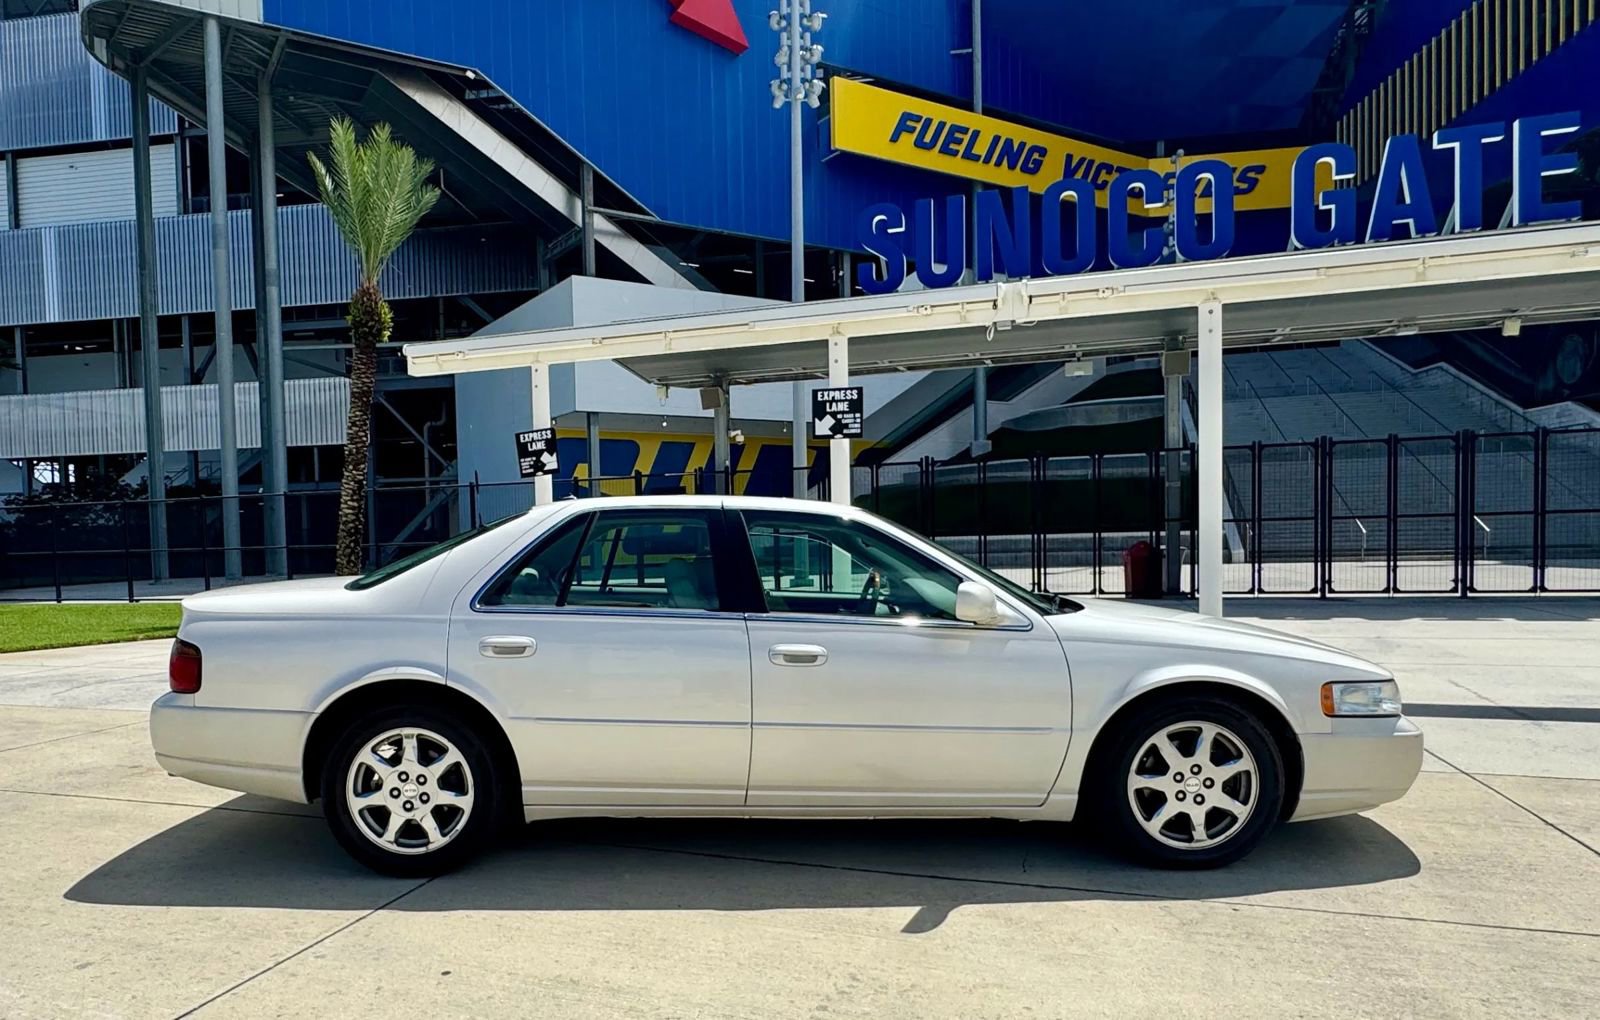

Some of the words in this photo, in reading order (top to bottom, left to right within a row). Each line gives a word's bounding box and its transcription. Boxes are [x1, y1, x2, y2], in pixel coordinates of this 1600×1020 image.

[889, 111, 1048, 175] FUELING
[857, 159, 1236, 295] SUNOCO
[1290, 110, 1582, 249] GATE
[817, 389, 858, 401] EXPRESS
[826, 401, 850, 412] LANE
[519, 430, 552, 443] EXPRESS
[527, 440, 547, 452] LANE
